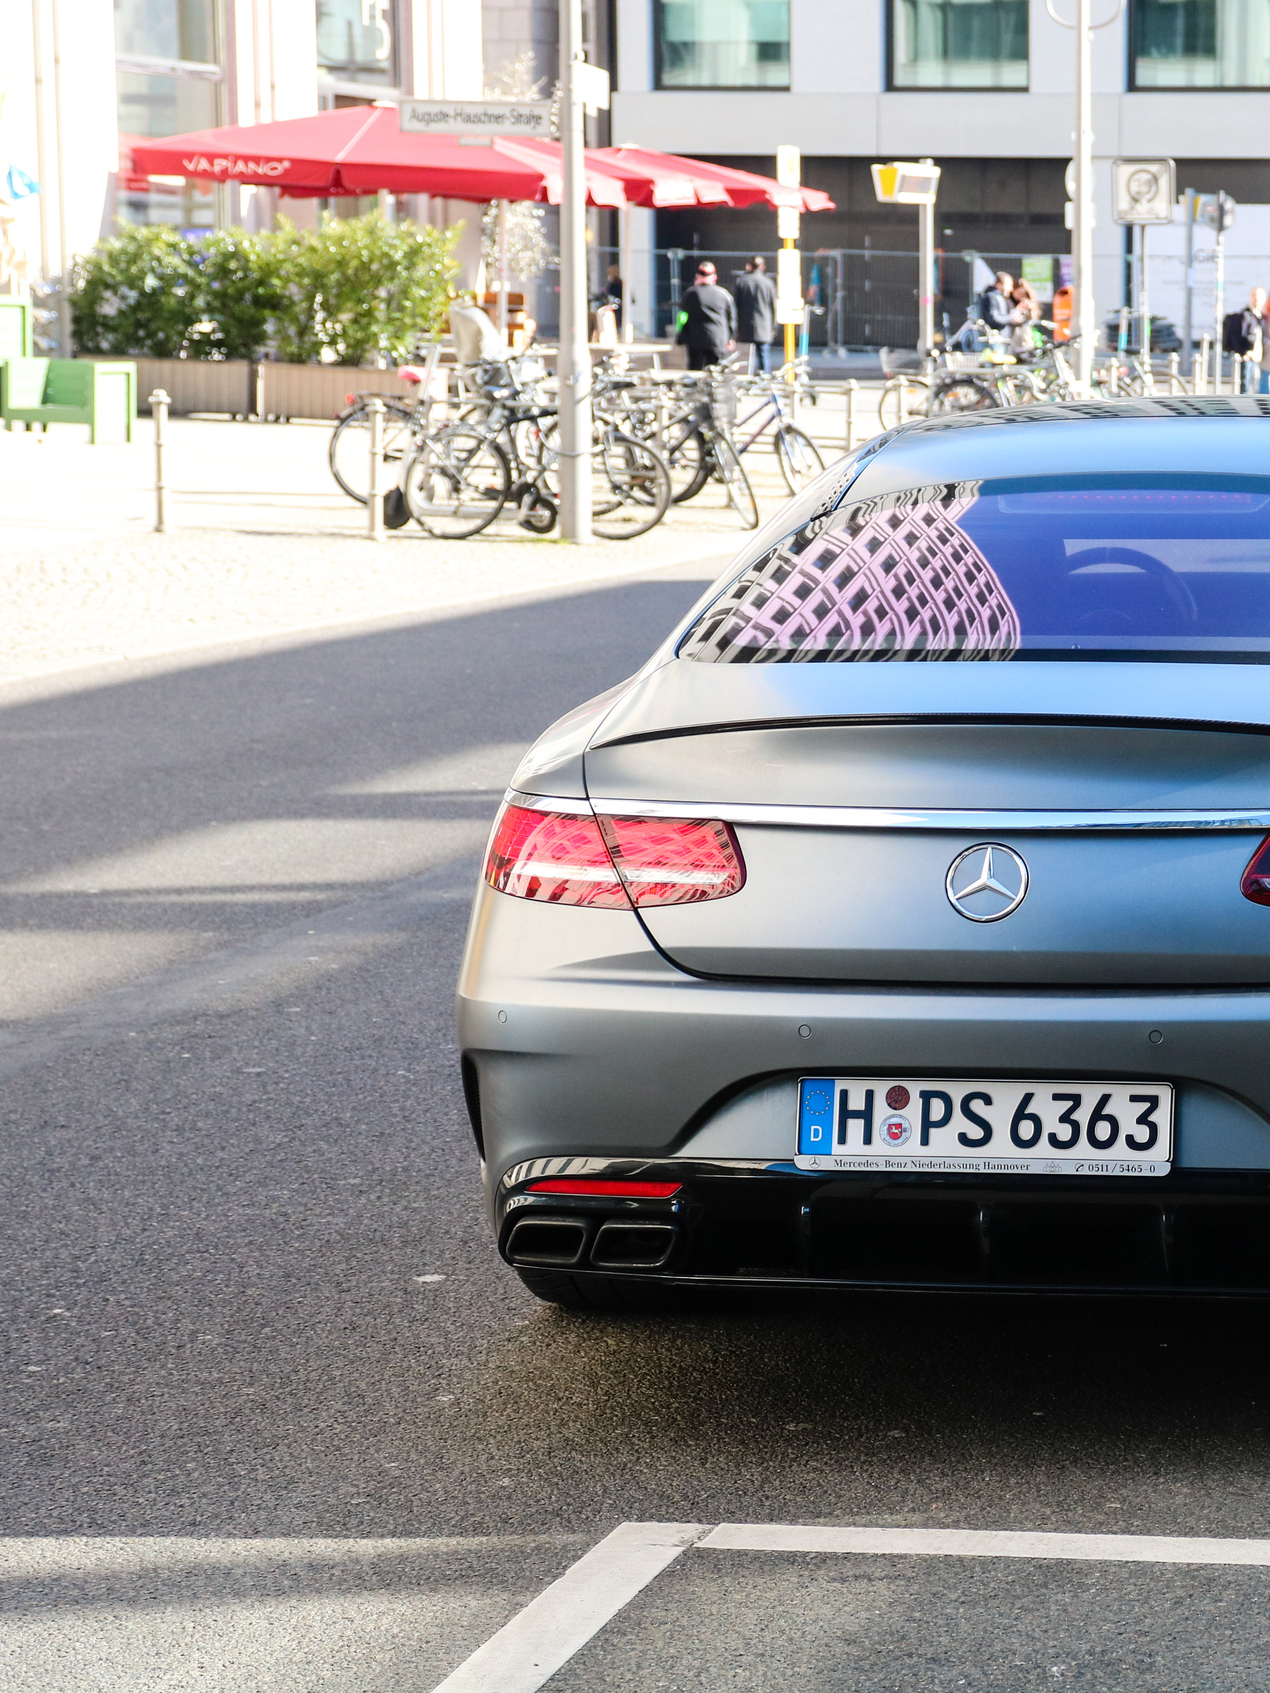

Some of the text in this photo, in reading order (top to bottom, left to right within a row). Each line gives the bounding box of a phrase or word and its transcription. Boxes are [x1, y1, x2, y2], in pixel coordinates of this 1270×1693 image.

[409, 107, 542, 129] Auguste-Hauschner-Straße
[837, 1089, 874, 1145] H
[919, 1090, 993, 1147] PS
[1009, 1092, 1159, 1151] 6363
[810, 1126, 823, 1141] D
[833, 1159, 908, 1169] Mercedes-Benz
[910, 1160, 980, 1171] Niederlassung
[983, 1161, 1031, 1171] Hannover
